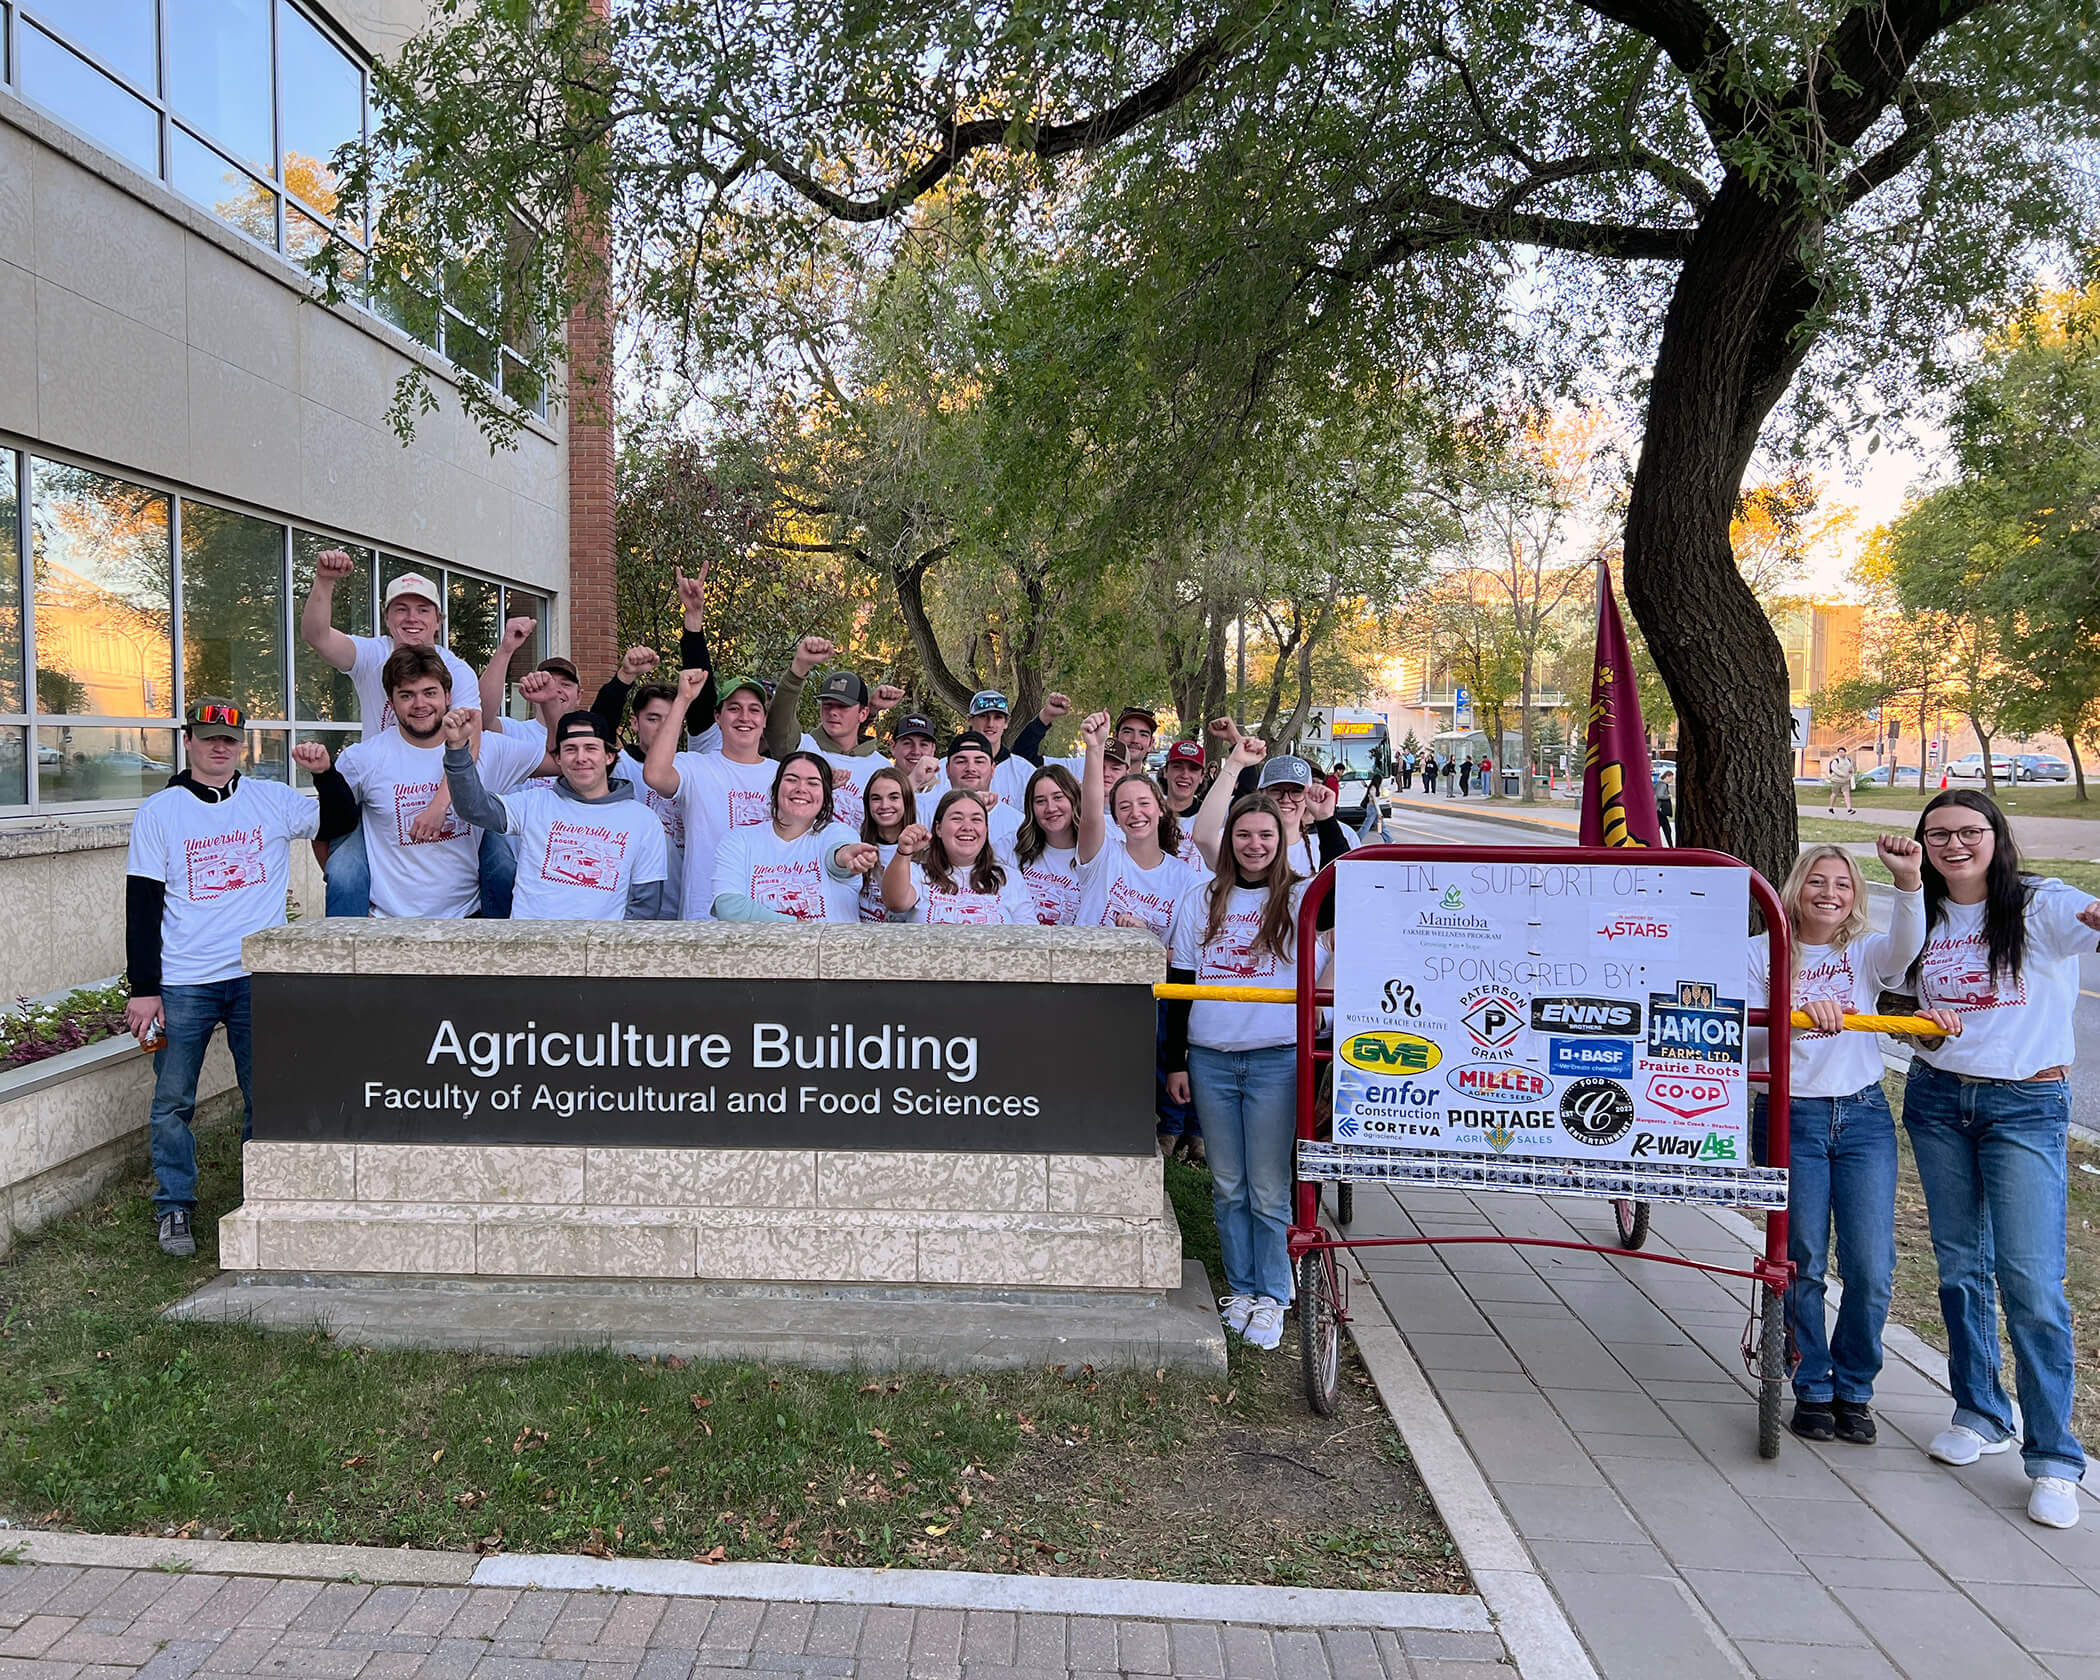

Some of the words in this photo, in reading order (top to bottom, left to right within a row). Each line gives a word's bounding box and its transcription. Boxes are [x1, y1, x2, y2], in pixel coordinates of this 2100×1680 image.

[393, 782, 439, 796] Univers
[552, 820, 611, 841] University
[184, 829, 247, 852] University
[1400, 865, 1435, 893] IN
[1471, 865, 1600, 896] SUPPORT
[1419, 911, 1488, 928] Manitoba
[1432, 930, 1465, 938] WELLNESS
[1615, 922, 1668, 938] STARS
[1424, 957, 1587, 986] SPONSORED
[1799, 962, 1836, 980] ersity
[1460, 985, 1527, 1008] PATERSON
[1346, 1014, 1379, 1024] MONTANA
[1383, 1018, 1409, 1027] GRACIE
[1413, 1020, 1448, 1031] CREATIVE
[1485, 1010, 1506, 1035] P
[1541, 1004, 1632, 1025] ENNS
[1651, 1014, 1741, 1046] JAMOR
[425, 1020, 731, 1078] Agriculture
[753, 1022, 978, 1083] Building
[1353, 1037, 1429, 1069] GVE
[1471, 1046, 1514, 1060] GRAIN
[1581, 1049, 1623, 1063] BASF
[1661, 1047, 1702, 1060] FARMS
[1707, 1051, 1734, 1063] LTD.
[1639, 1060, 1689, 1073] Prairie
[1695, 1064, 1740, 1077] Roots
[1459, 1071, 1544, 1094] MILLER
[1580, 1078, 1604, 1087] FOOD
[364, 1081, 480, 1119] Faculty
[490, 1084, 522, 1110] of
[531, 1083, 716, 1118] Agricultural
[727, 1086, 787, 1114] and
[799, 1086, 881, 1115] Food
[892, 1087, 1041, 1117] Sciences
[1366, 1080, 1440, 1106] enfor
[1469, 1090, 1507, 1099] AGRITEC
[1355, 1104, 1440, 1120] Construction
[1447, 1110, 1555, 1128] PORTAGE
[1363, 1132, 1402, 1140] agriscience
[1364, 1121, 1440, 1137] CORTEVA
[1568, 1121, 1631, 1145] ENTERTAINMENT
[1455, 1135, 1482, 1143] AGRI
[1517, 1135, 1553, 1144] SALES
